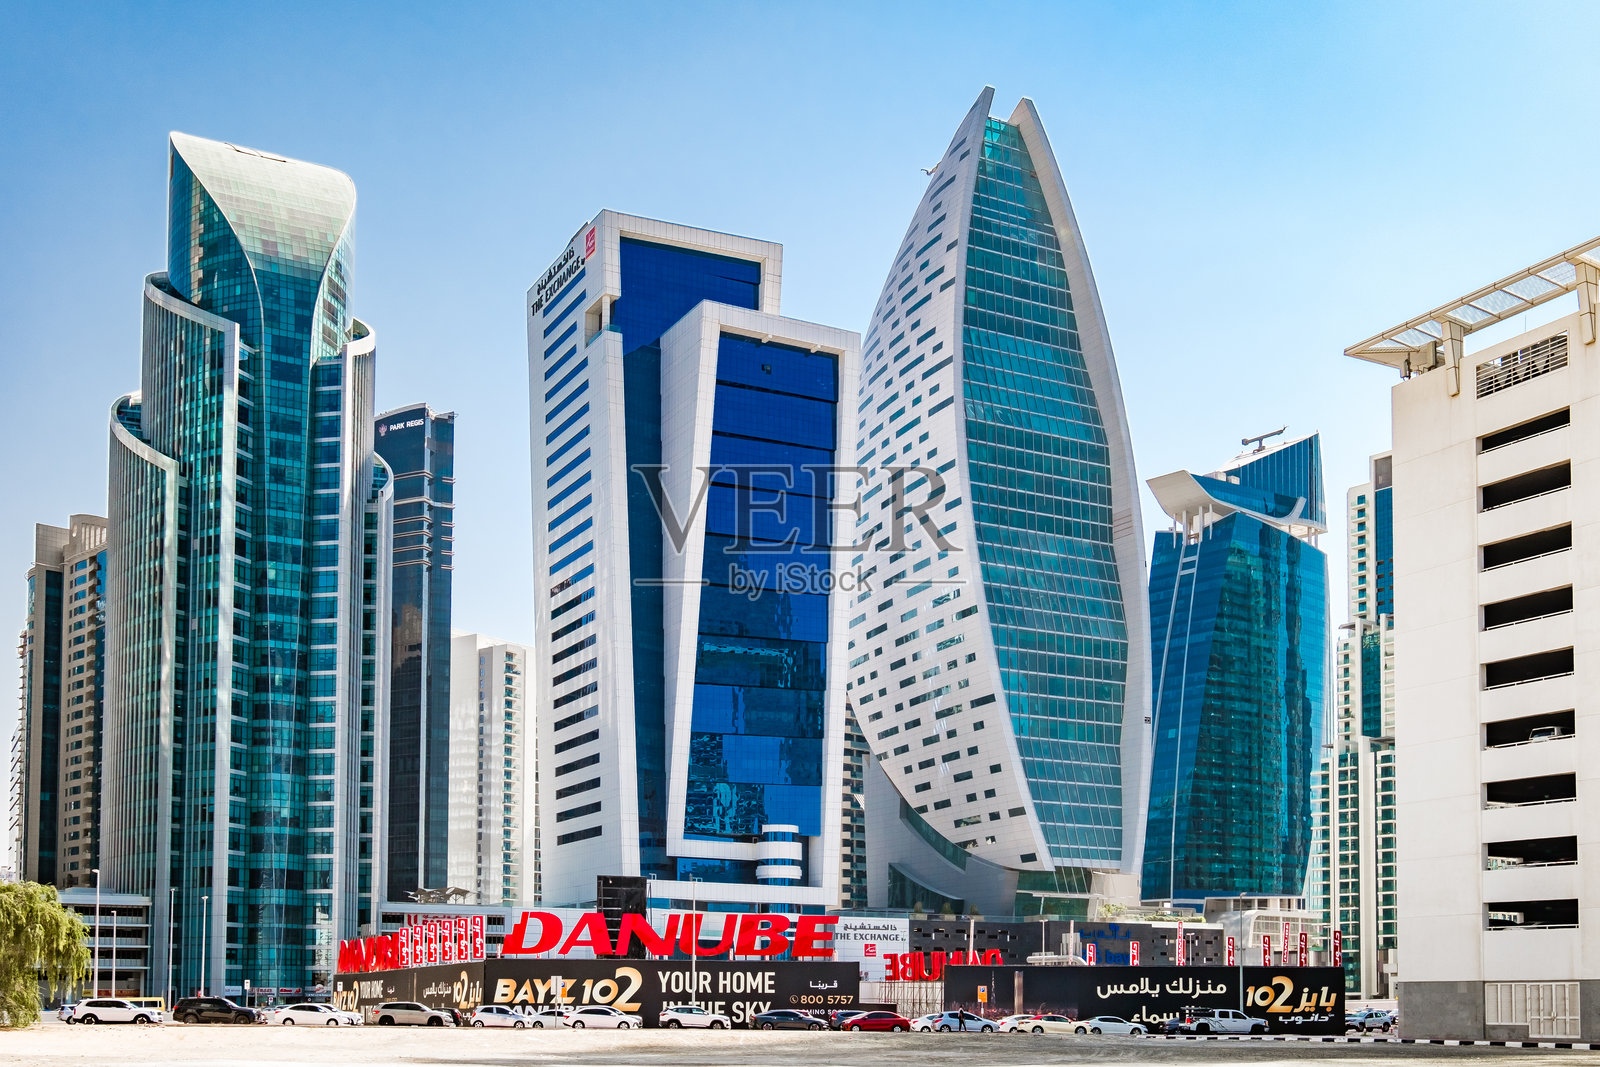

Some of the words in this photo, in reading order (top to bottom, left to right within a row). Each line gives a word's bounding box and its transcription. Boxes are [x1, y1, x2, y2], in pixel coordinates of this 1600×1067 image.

[531, 295, 544, 316] THE
[545, 256, 580, 303] EXCHANGE
[389, 423, 404, 431] PARK
[406, 419, 424, 428] REGIS
[503, 912, 839, 957] DANUBE
[453, 971, 468, 1009] 102
[493, 979, 577, 1004] BAYZ
[582, 967, 643, 1011] 102
[657, 971, 712, 993] YOUR
[718, 972, 775, 993] HOME
[1096, 977, 1160, 999] يلامس
[1165, 977, 1227, 999] منزلك
[801, 995, 824, 1004] 800
[827, 995, 853, 1004] 5757
[1246, 976, 1293, 1013] 102
[1293, 986, 1337, 1012] بايز
[731, 1001, 771, 1023] SKY
[1278, 1013, 1329, 1024] دانوب
